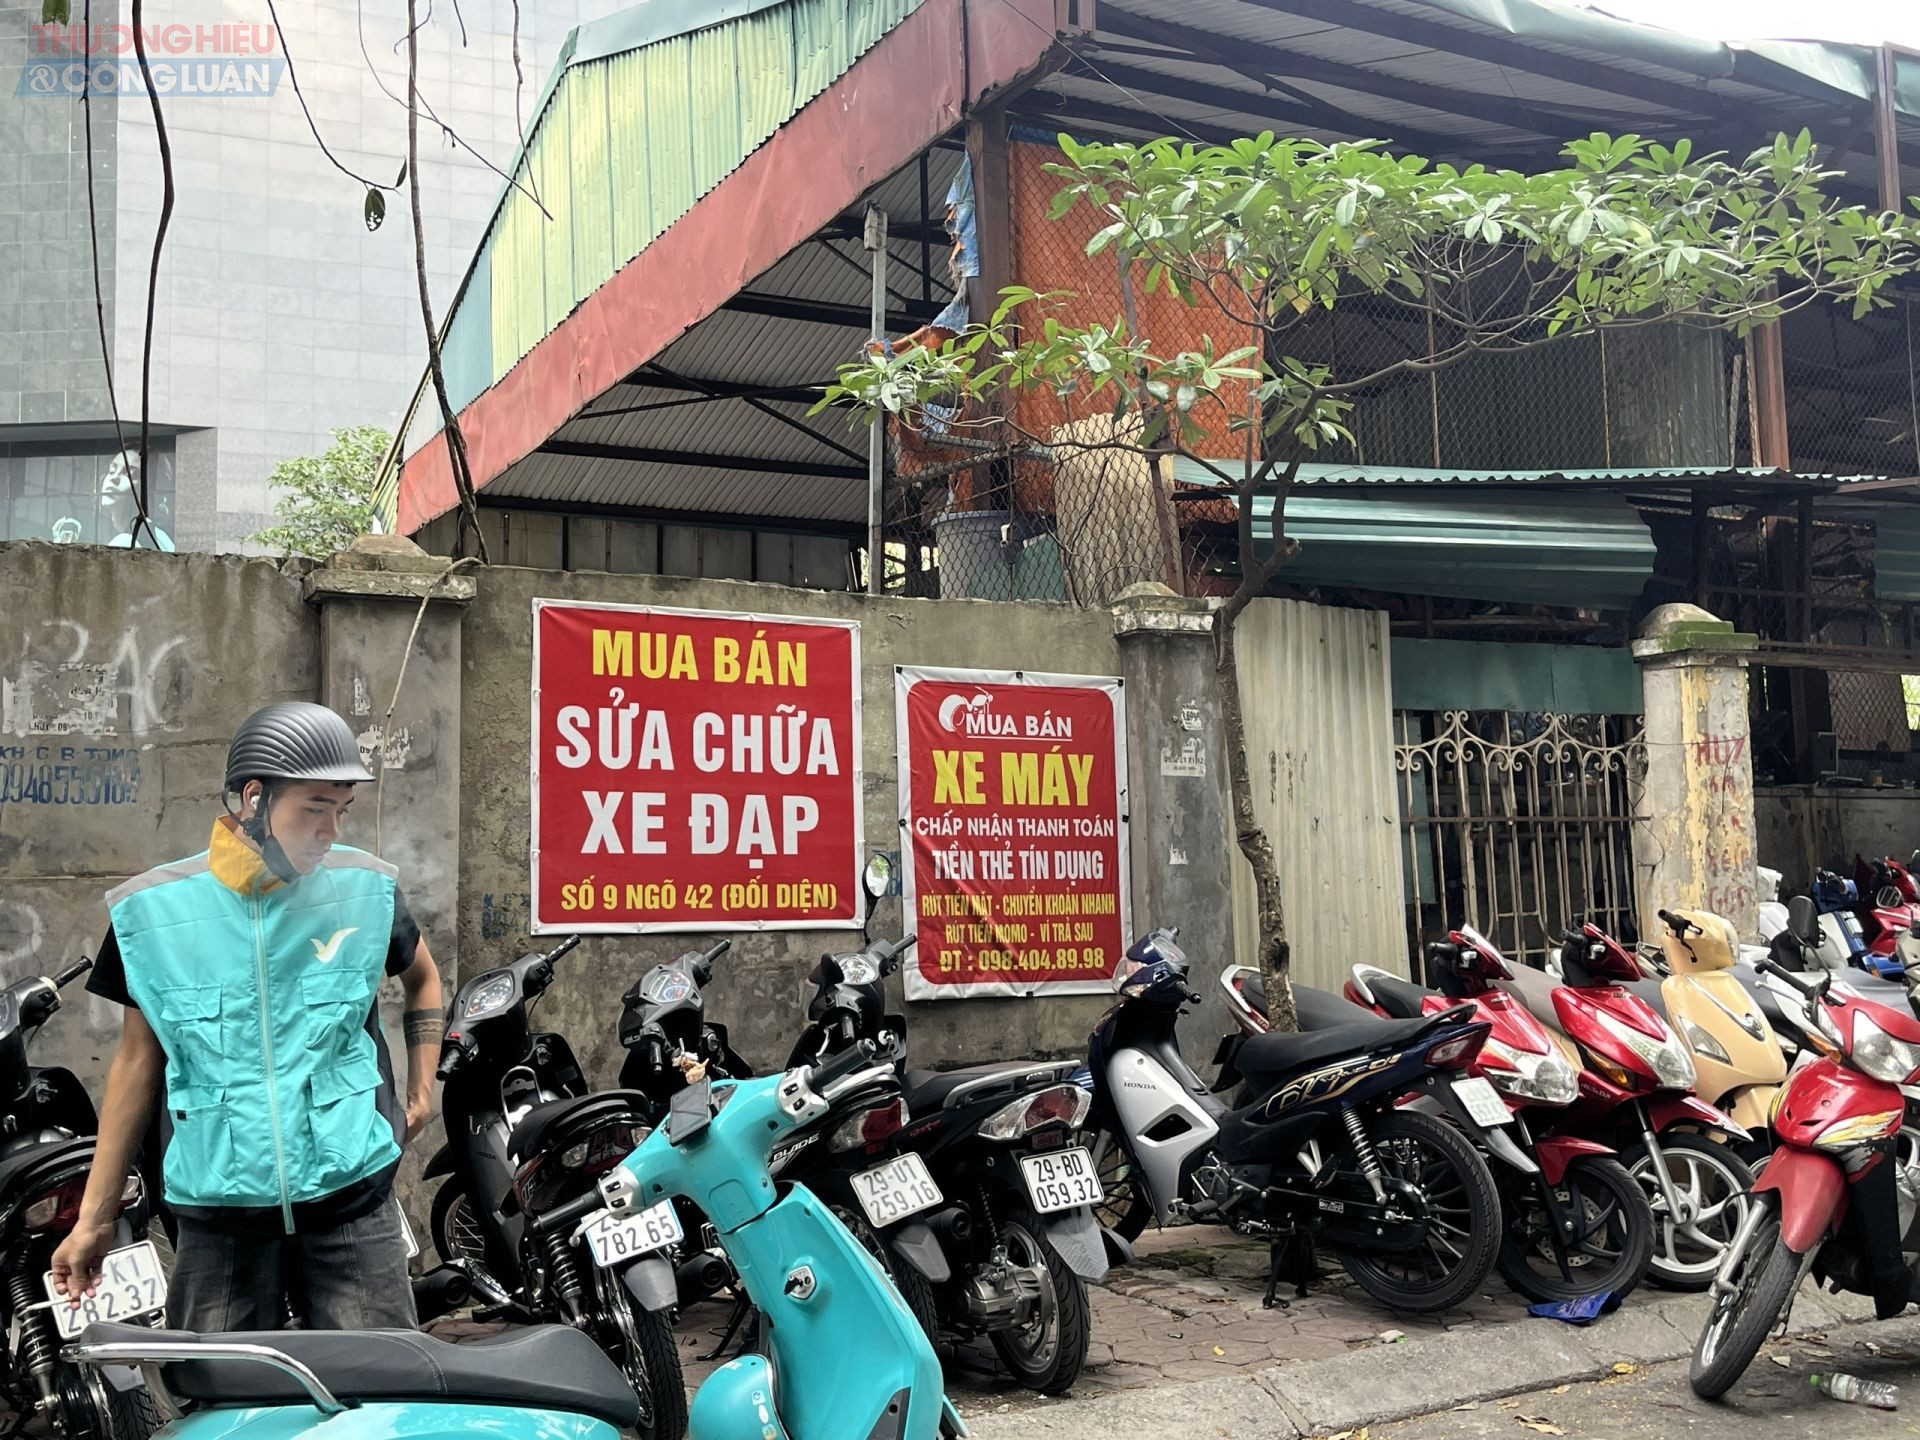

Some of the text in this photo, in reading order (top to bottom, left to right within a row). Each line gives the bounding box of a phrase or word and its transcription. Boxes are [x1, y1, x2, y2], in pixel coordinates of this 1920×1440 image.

[592, 629, 807, 687] MUA BÁN
[555, 687, 840, 775] SỬA CHỮA
[966, 710, 1072, 737] MUA BÁN
[932, 745, 1094, 806] XE MÁY
[580, 790, 819, 869] XE ĐẠP
[916, 809, 1114, 841] CHẤP NHẬN THANH TOÁN
[932, 841, 974, 880] TIỀN
[979, 841, 1014, 880] THẺ
[1019, 844, 1049, 880] TÍN
[1055, 850, 1103, 886] DỤNG
[561, 875, 596, 910] SỐ
[603, 884, 618, 910] 9
[625, 879, 677, 910] NGÕ
[684, 884, 713, 909] 42
[721, 875, 768, 911] (ĐỐI
[776, 879, 837, 913] DIỆN)
[922, 890, 942, 917] RÚT
[1045, 887, 1079, 915] KHOẢN
[1081, 893, 1115, 914] NHANH
[945, 919, 966, 944] RÚT
[994, 923, 1027, 943] MOMO
[1040, 919, 1050, 942] VÍ
[1052, 917, 1071, 942] TRẢ
[1074, 922, 1093, 941] SAU
[940, 950, 962, 972] ĐT
[978, 948, 1104, 971] 098.404.89.98
[1123, 1081, 1157, 1090] HONDA
[773, 1132, 820, 1161] BLADE
[863, 1159, 917, 1196] 29-U1
[1033, 1153, 1083, 1183] 29-BD
[870, 1181, 936, 1221] 259.16
[1036, 1177, 1098, 1209] 059.32
[597, 1215, 675, 1261] 782.65
[62, 1277, 157, 1333] 282.37
